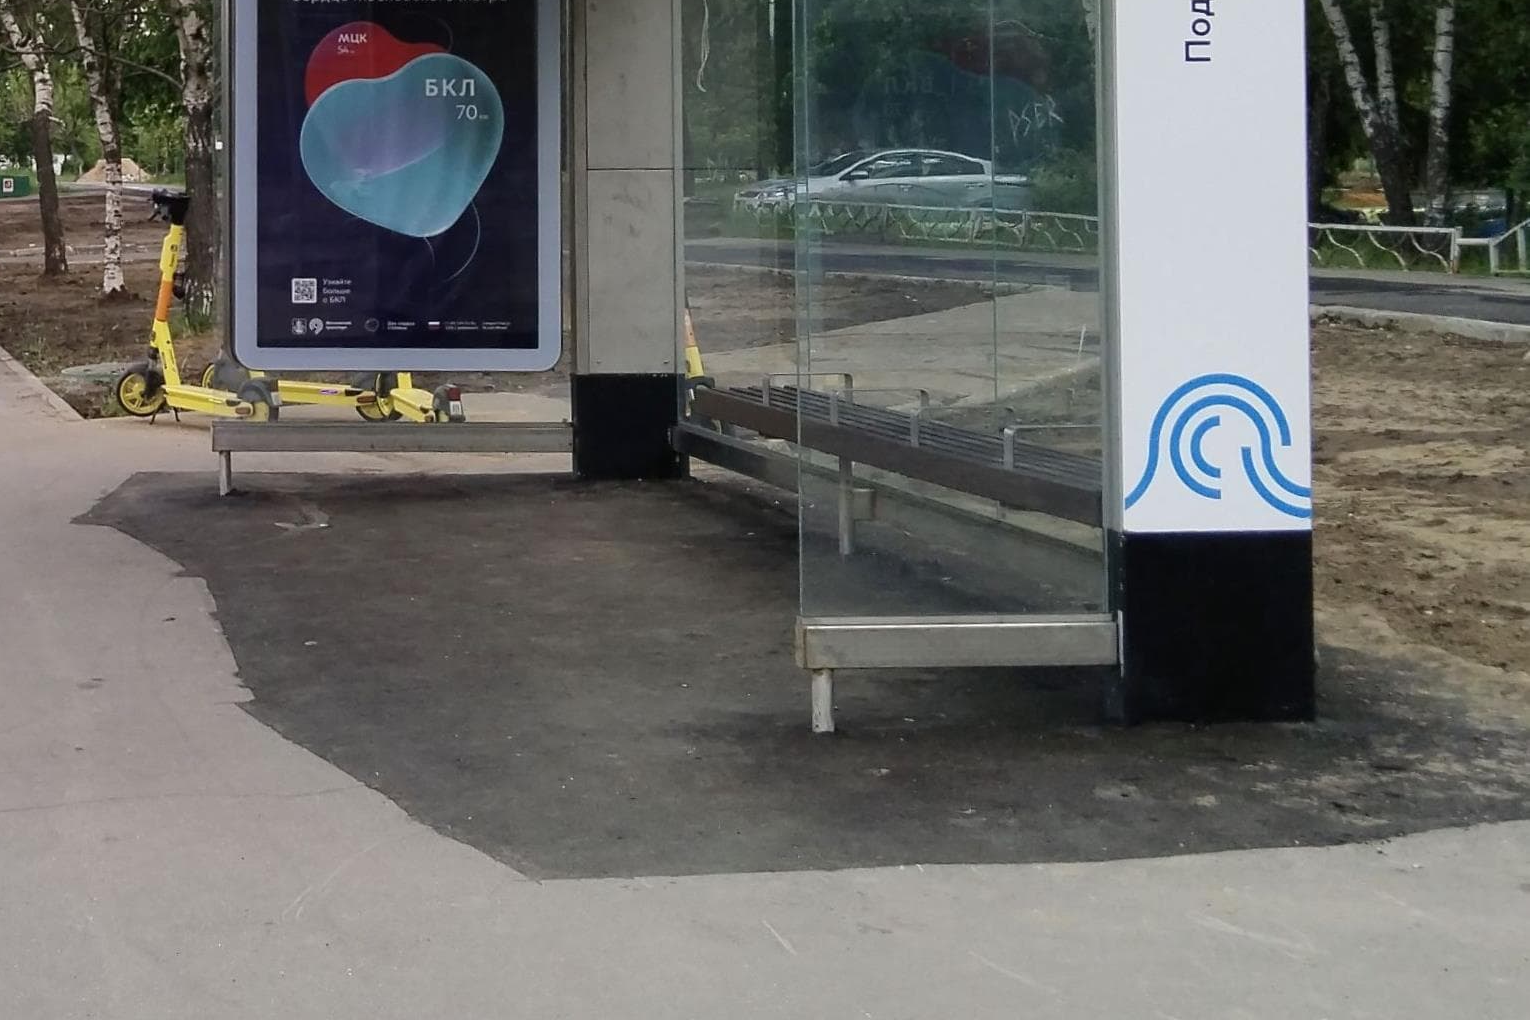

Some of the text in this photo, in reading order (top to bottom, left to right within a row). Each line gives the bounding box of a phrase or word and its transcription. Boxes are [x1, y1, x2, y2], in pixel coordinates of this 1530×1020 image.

[338, 33, 368, 44] МЦК
[425, 78, 476, 97] БКЛ
[455, 104, 478, 120] 70
